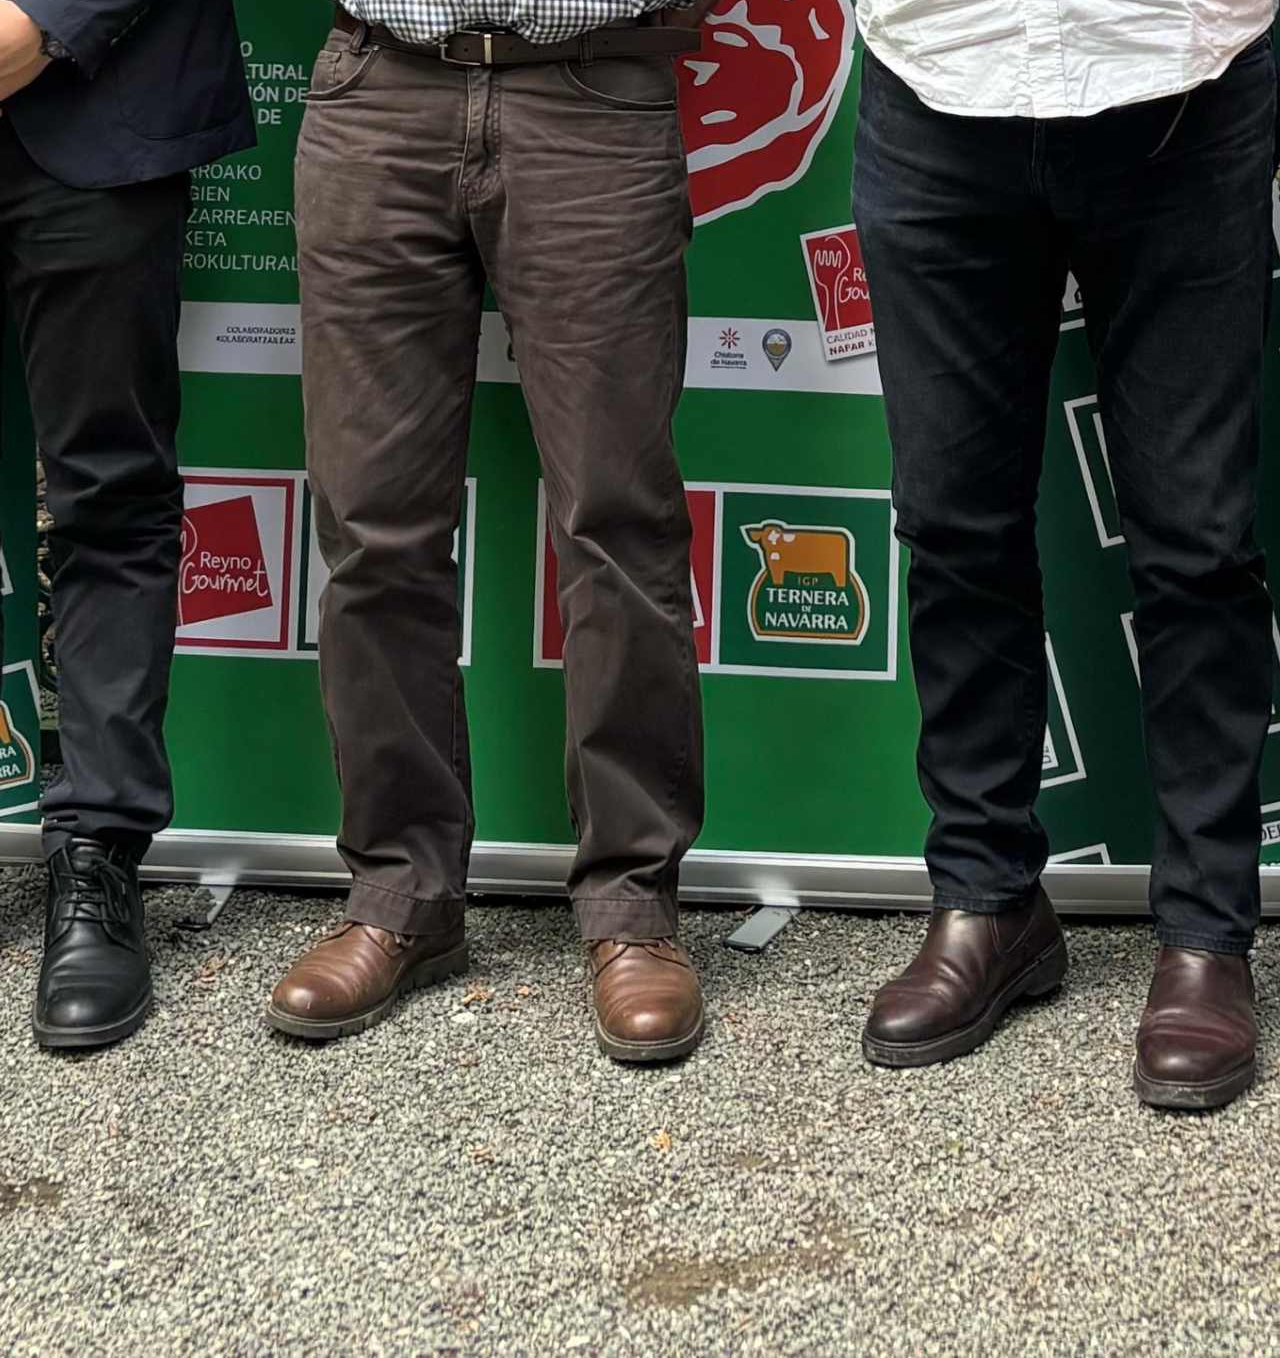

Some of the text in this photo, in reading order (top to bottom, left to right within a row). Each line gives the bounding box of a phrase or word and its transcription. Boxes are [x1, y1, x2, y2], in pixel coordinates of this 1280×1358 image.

[245, 63, 308, 81] TURAL
[284, 88, 309, 103] DE
[257, 109, 282, 125] DE
[191, 186, 230, 202] GIEN
[187, 210, 296, 226] ZARREAREN
[183, 253, 299, 271] ROKULTURAL
[200, 551, 252, 573] Reyno
[182, 559, 268, 597] Gourmet
[766, 587, 850, 606] TERNERA
[765, 611, 849, 631] NAVARRA
